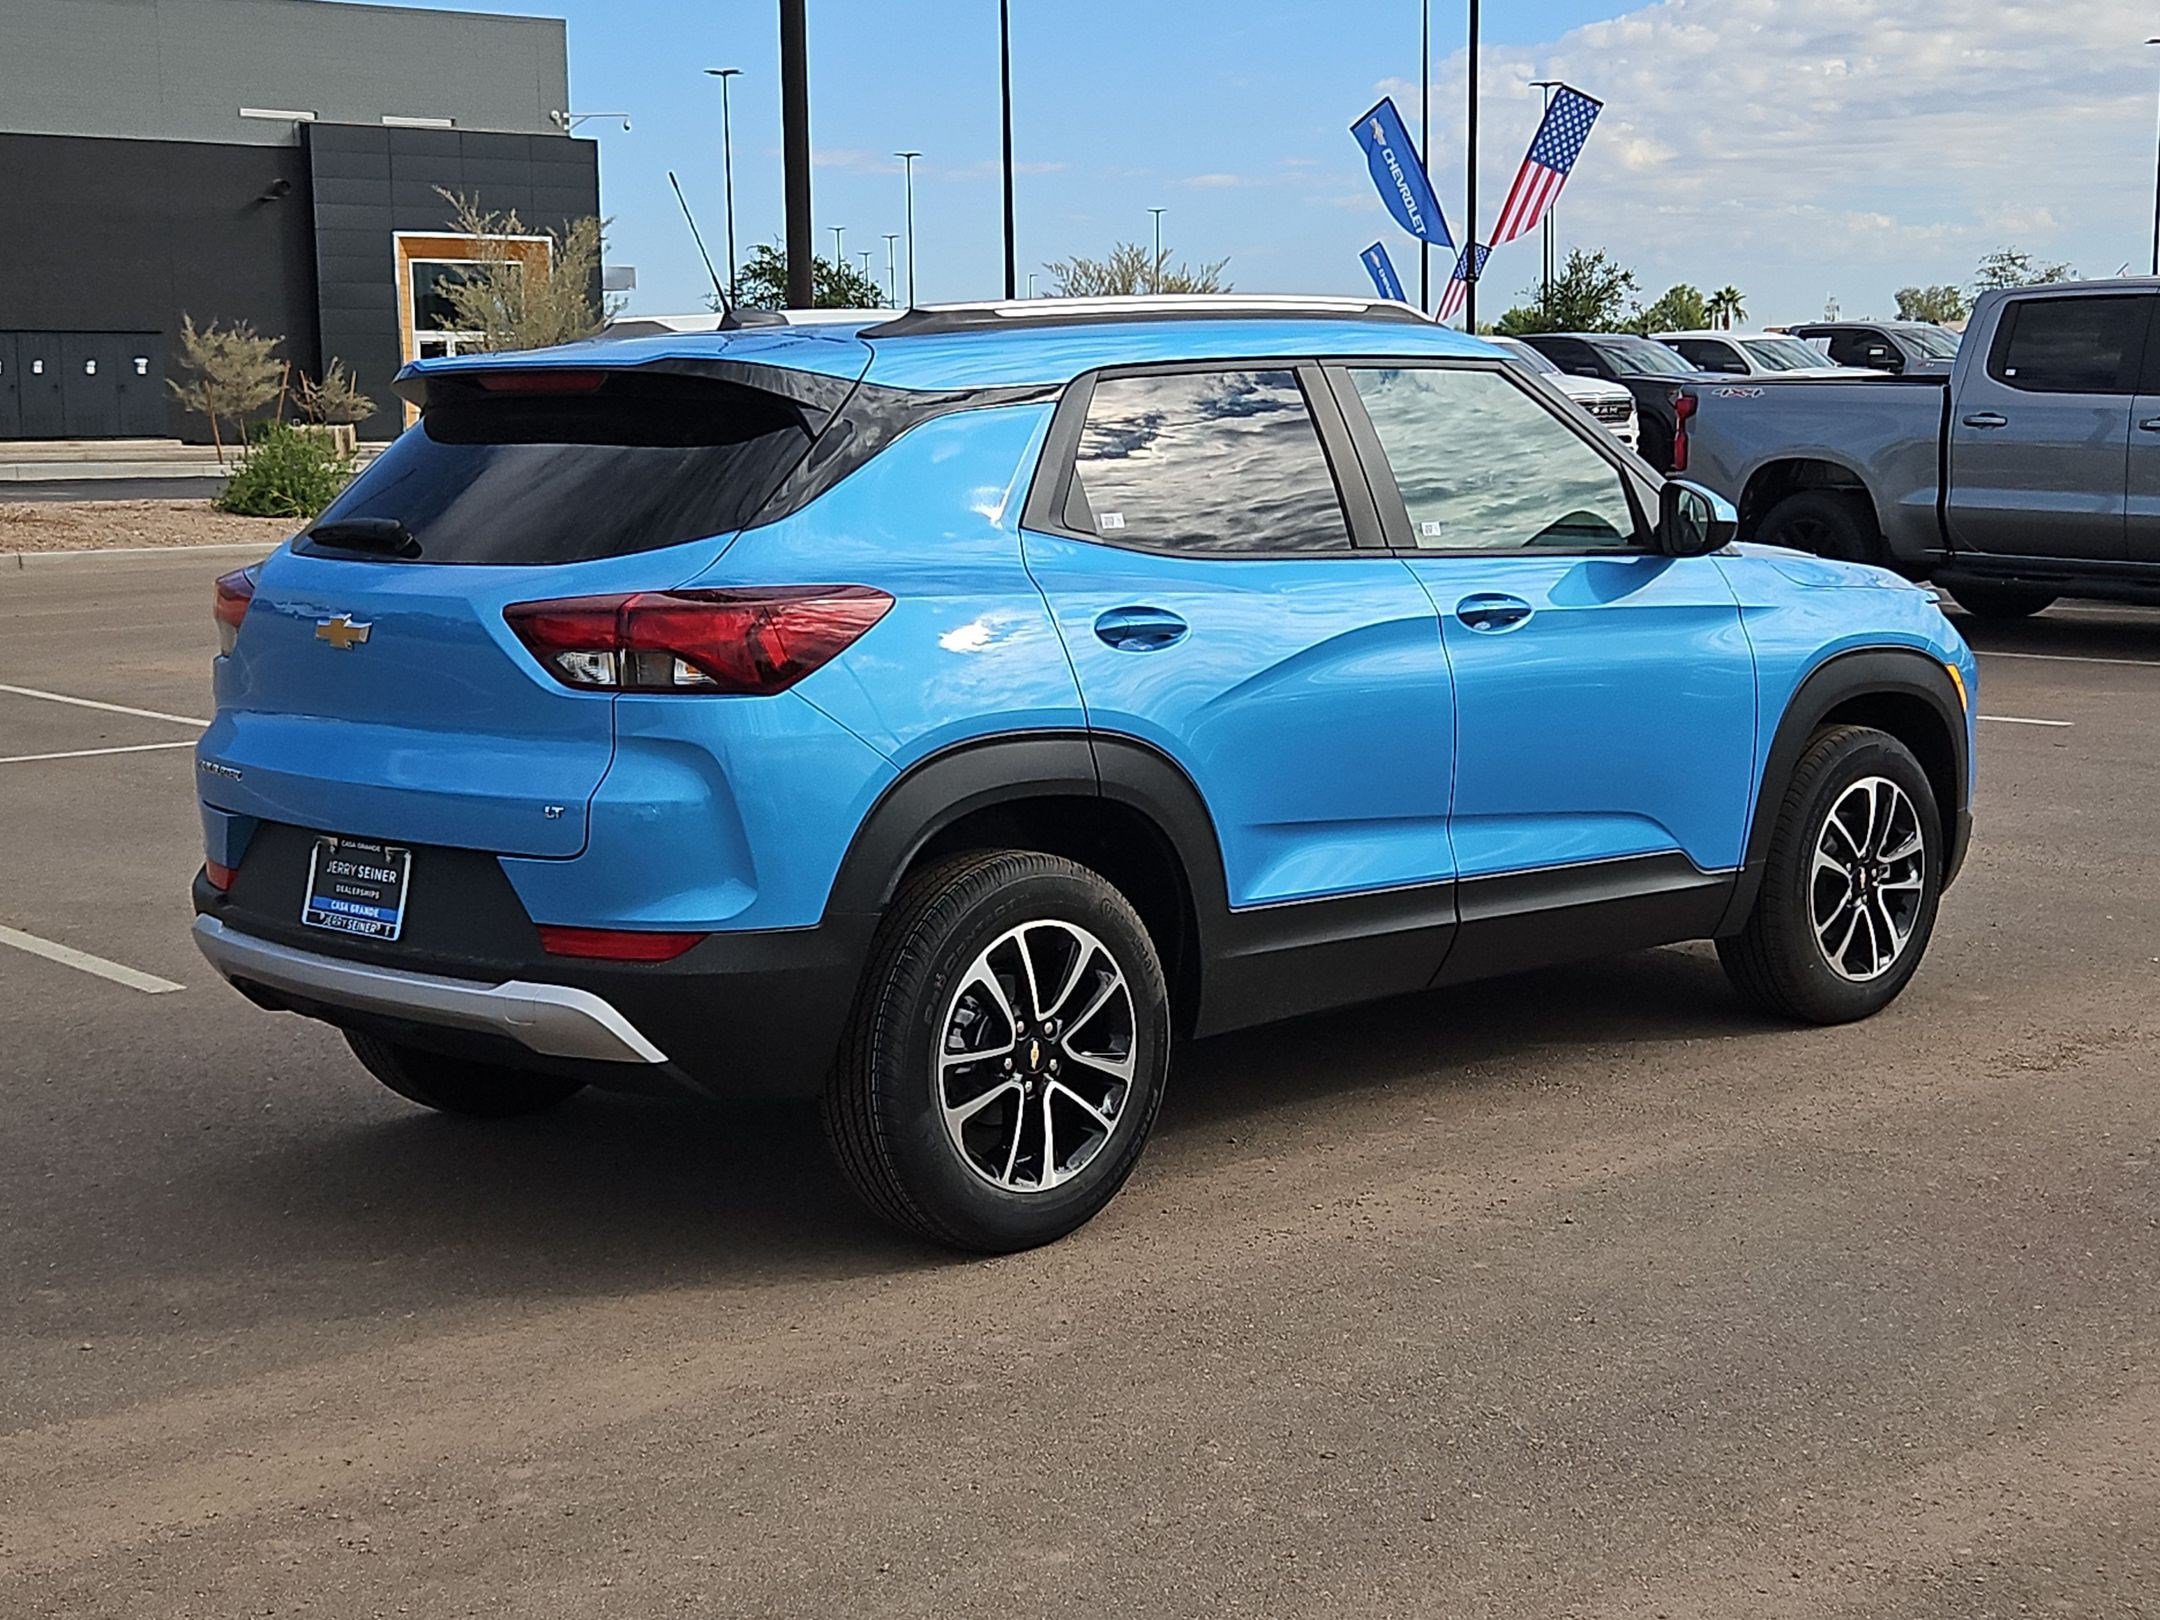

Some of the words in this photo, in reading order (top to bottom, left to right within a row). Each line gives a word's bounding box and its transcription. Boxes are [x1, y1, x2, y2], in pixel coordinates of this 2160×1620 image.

[1382, 148, 1426, 234] CHEVROLET
[544, 806, 564, 819] LT
[326, 860, 357, 876] JERRY
[358, 865, 397, 883] SEINER
[331, 900, 349, 912] CASA
[350, 904, 380, 918] GRANDE
[323, 915, 346, 928] JERRY
[347, 920, 376, 933] SEINER
